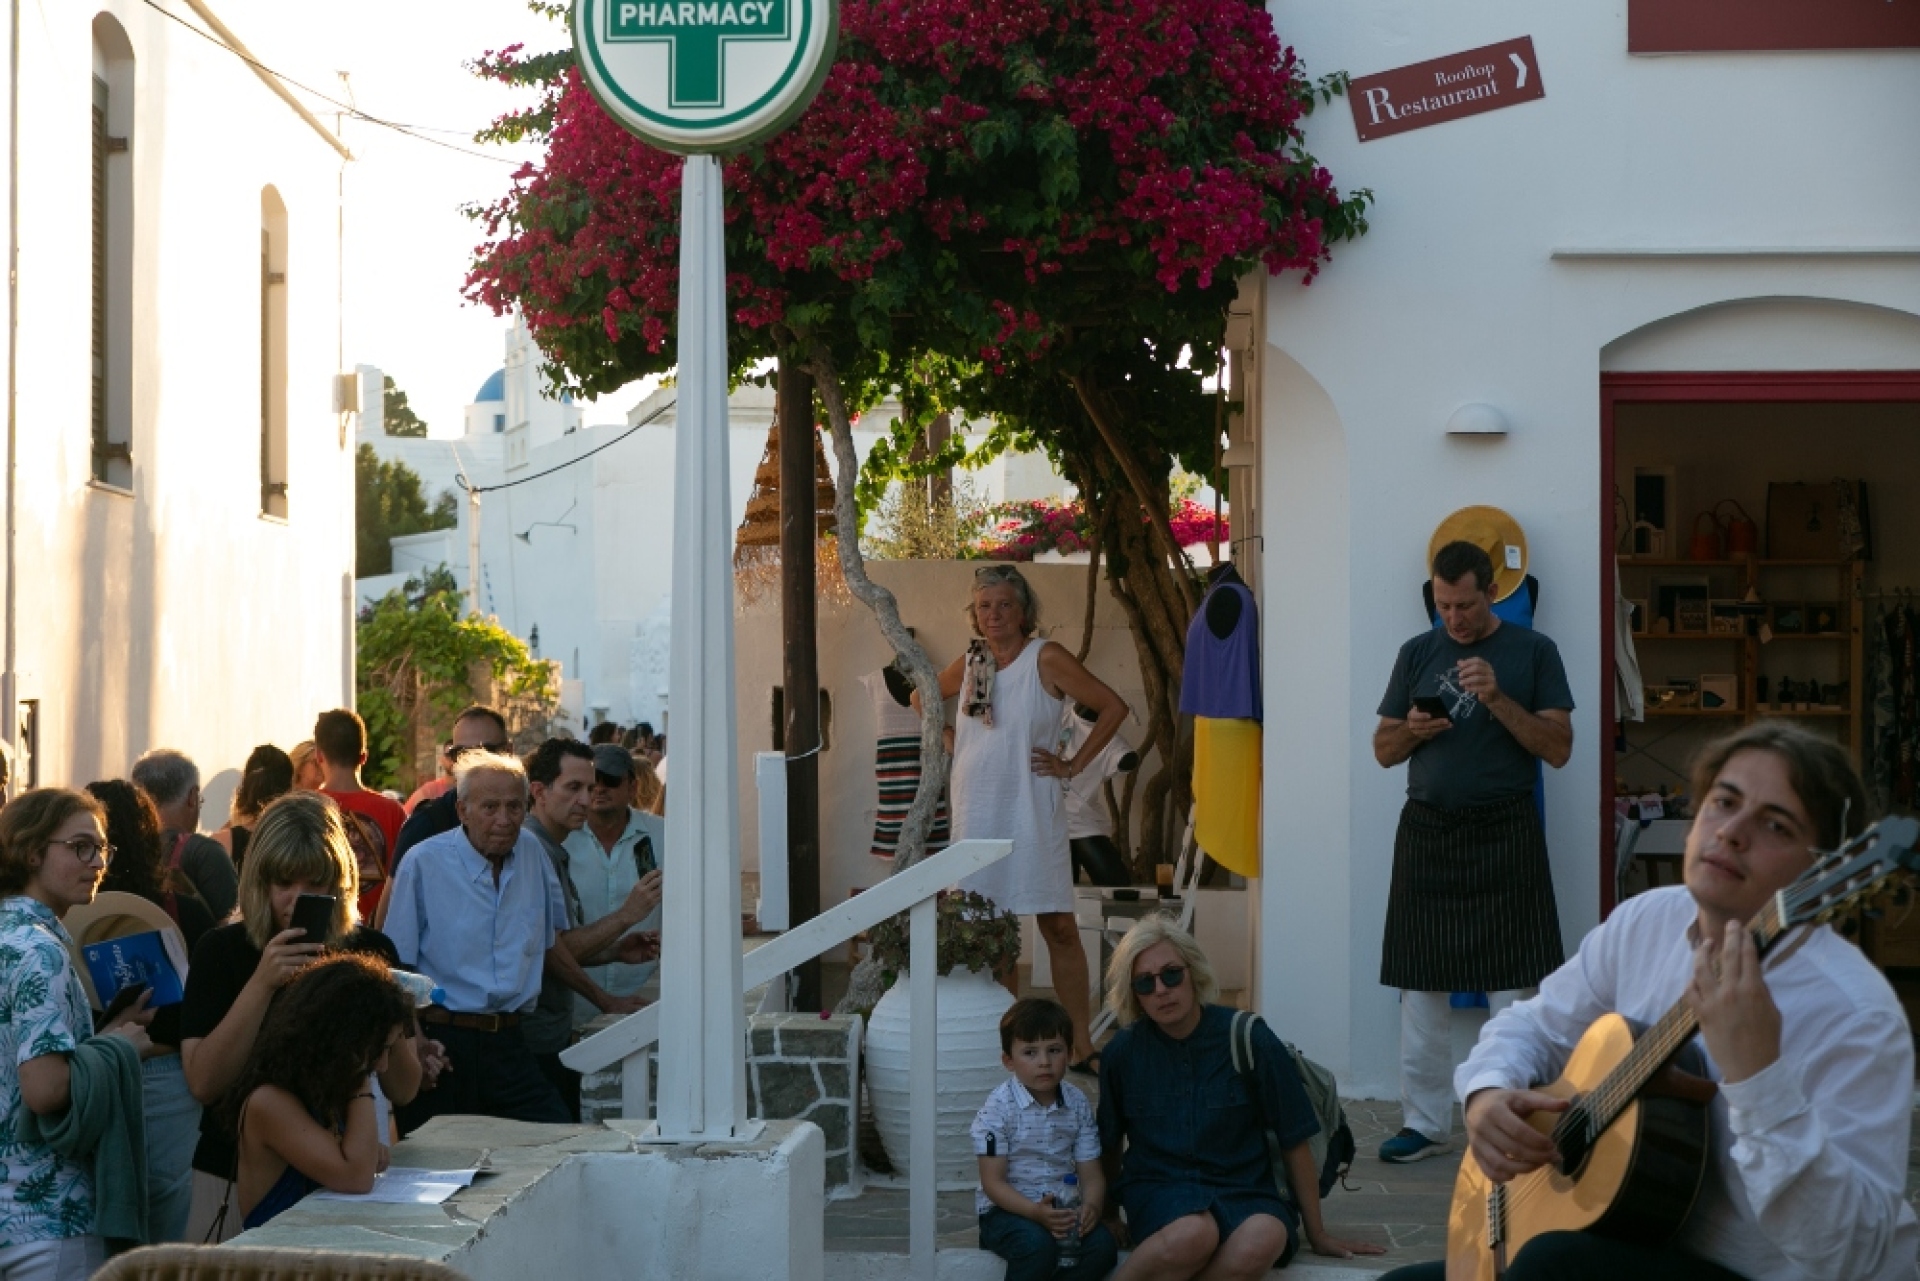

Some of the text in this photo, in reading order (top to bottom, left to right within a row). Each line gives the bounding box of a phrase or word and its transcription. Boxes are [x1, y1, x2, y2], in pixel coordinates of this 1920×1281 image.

[620, 2, 773, 26] PHARMACY
[1434, 63, 1495, 86] Rooftop
[1362, 79, 1500, 125] Restaurant
